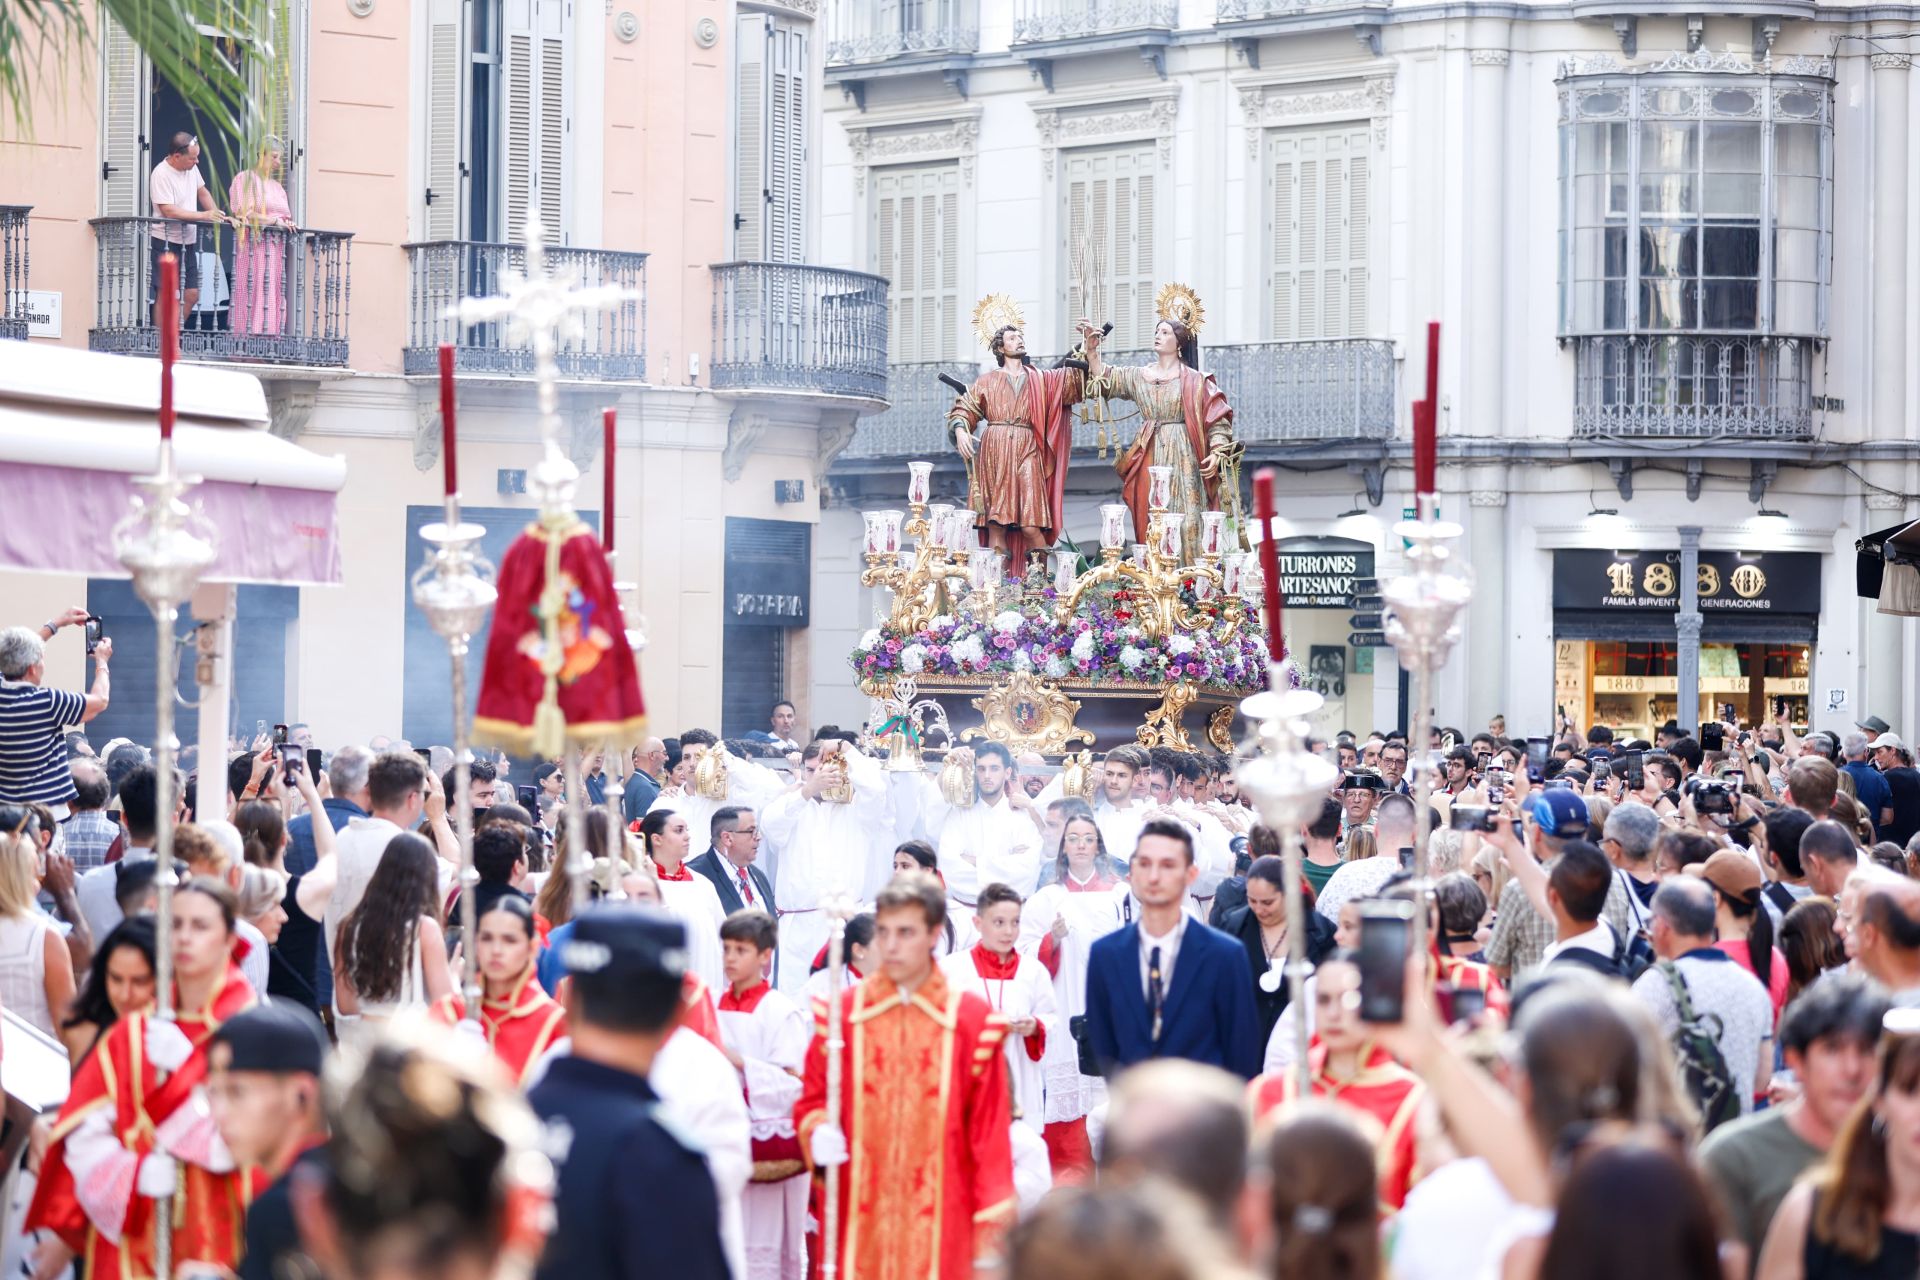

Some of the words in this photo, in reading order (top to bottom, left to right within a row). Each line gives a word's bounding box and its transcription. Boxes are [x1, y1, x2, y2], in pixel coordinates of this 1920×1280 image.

[1278, 555, 1357, 574] TURRONES
[1606, 562, 1767, 599] 1880
[1316, 597, 1346, 606] ALICANTE
[1602, 596, 1637, 606] FAMILIA
[1638, 597, 1676, 607] SIRVENT
[1700, 599, 1771, 609] GENERACIONES
[1607, 678, 1645, 691] 1880
